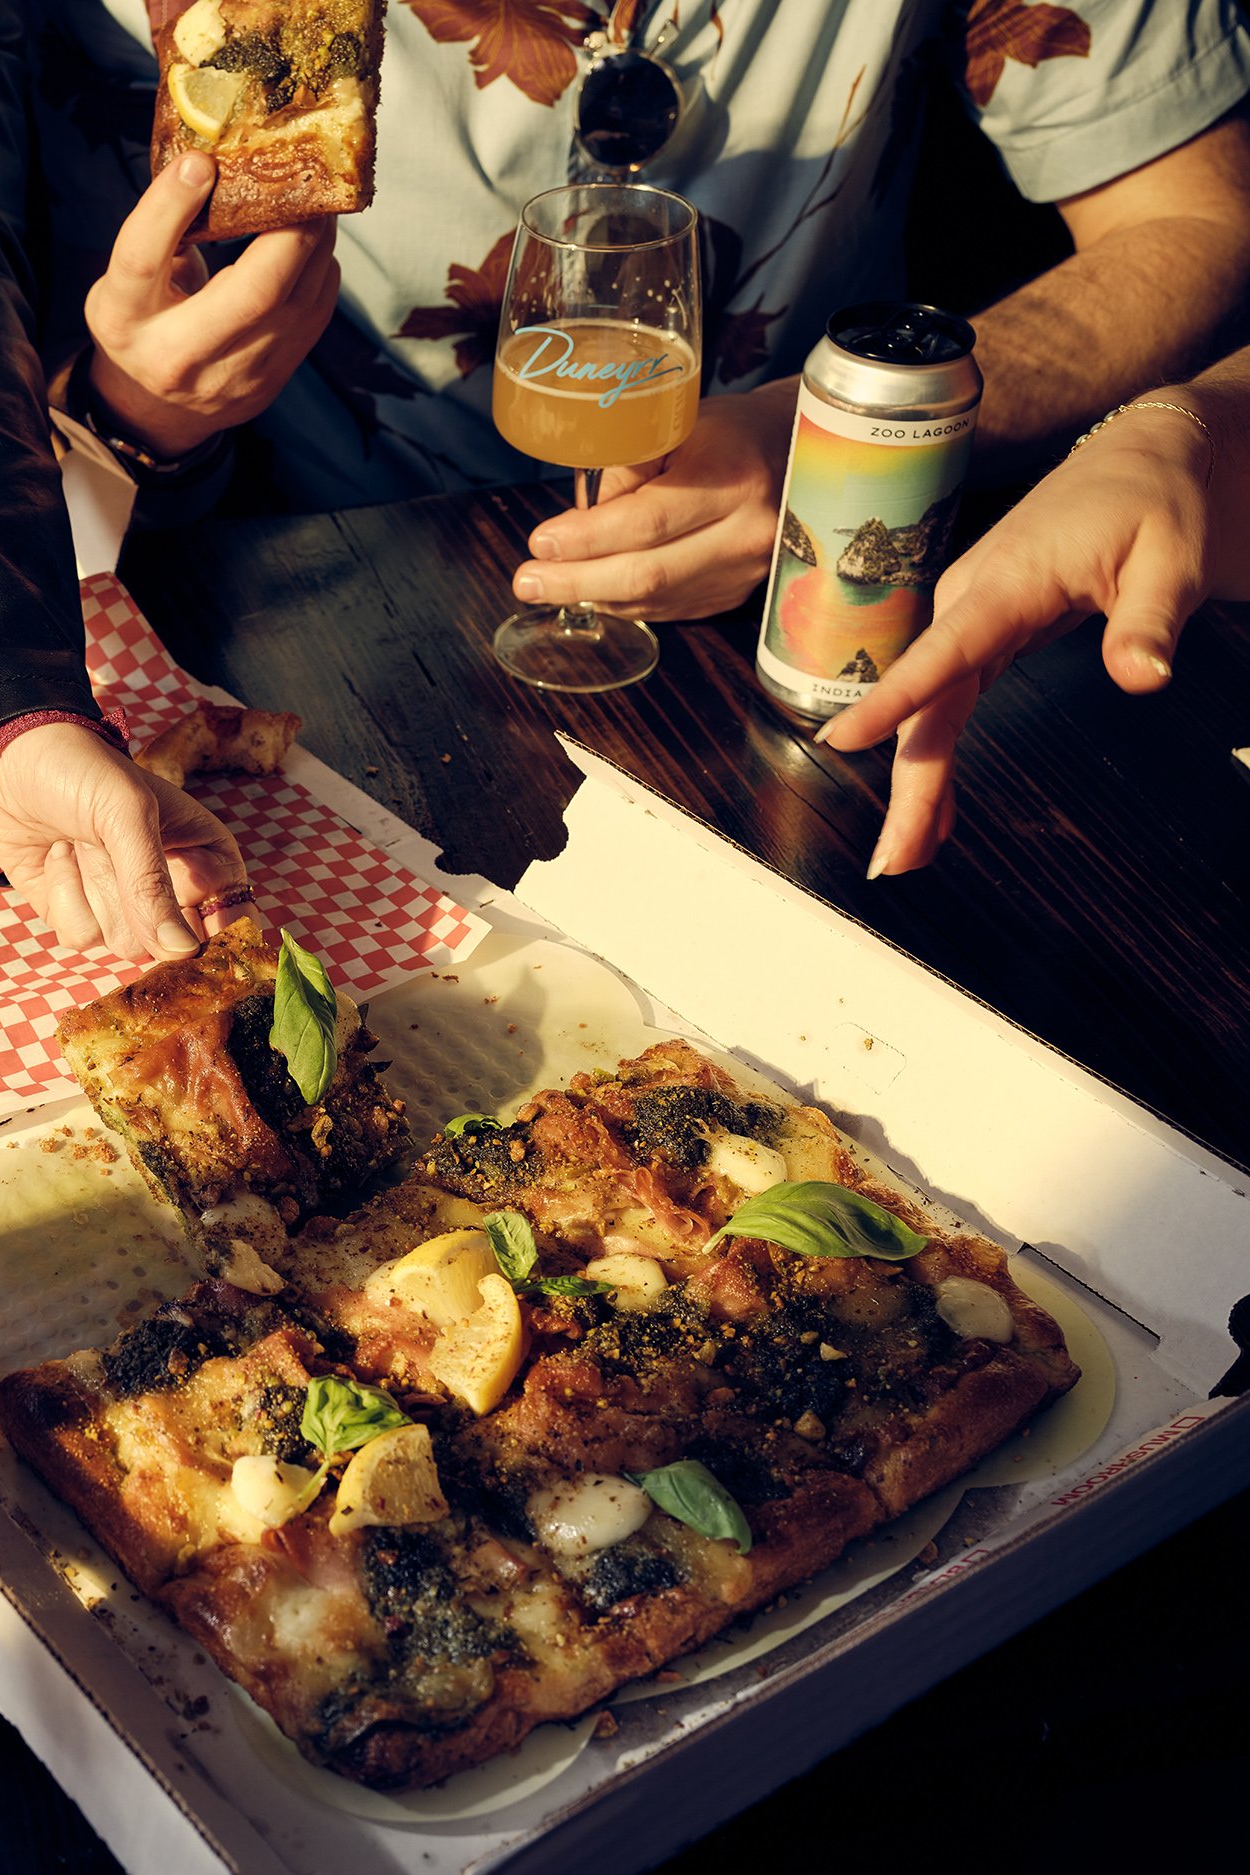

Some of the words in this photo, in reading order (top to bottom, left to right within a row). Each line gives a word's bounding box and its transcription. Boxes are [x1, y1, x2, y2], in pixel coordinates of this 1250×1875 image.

[870, 426, 906, 439] ZOO
[912, 418, 970, 439] LAGOON
[813, 683, 862, 697] INDIA
[1051, 1429, 1180, 1507] MUSHROOM
